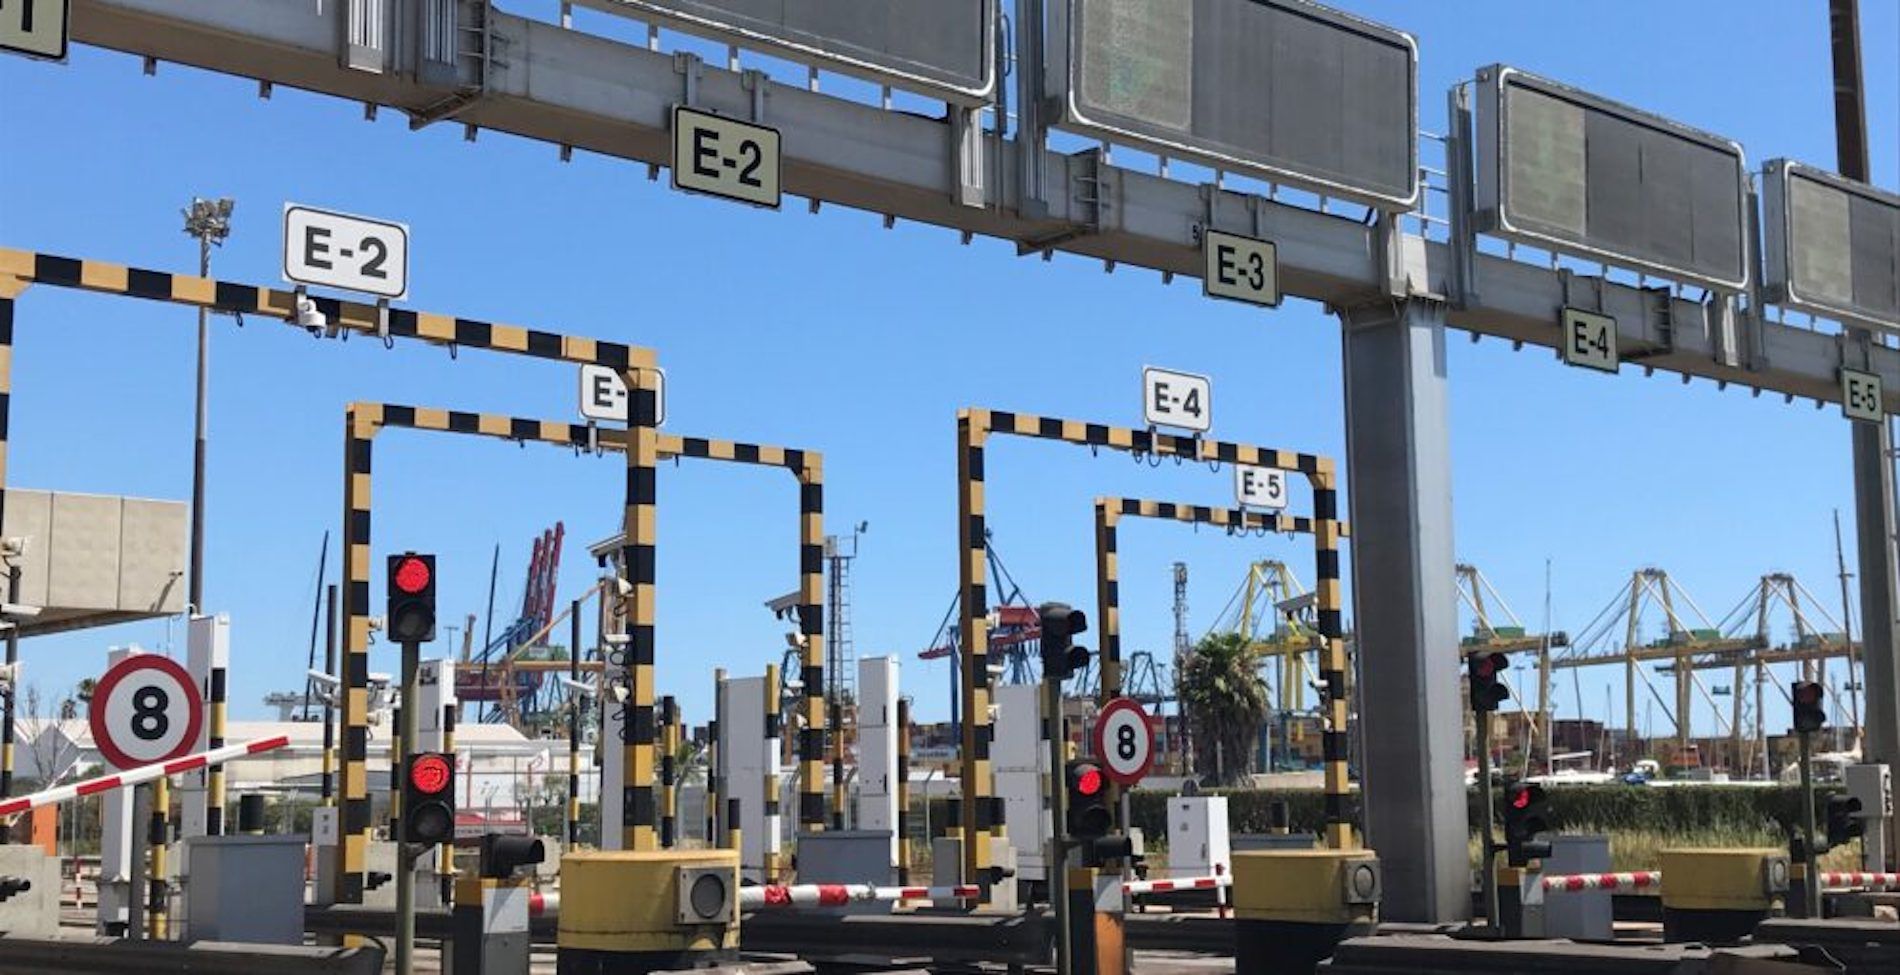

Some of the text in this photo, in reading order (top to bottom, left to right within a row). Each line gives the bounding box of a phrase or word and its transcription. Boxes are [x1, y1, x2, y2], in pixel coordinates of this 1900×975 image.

[694, 127, 761, 187] E-2
[304, 225, 387, 279] E-2
[1218, 245, 1263, 290] E-3
[1574, 321, 1609, 359] E-4
[594, 375, 626, 407] E-
[1154, 382, 1201, 419] E-4
[1850, 380, 1876, 411] E-5
[1243, 471, 1280, 499] E-5
[131, 685, 168, 740] 8
[1117, 724, 1135, 760] 8
